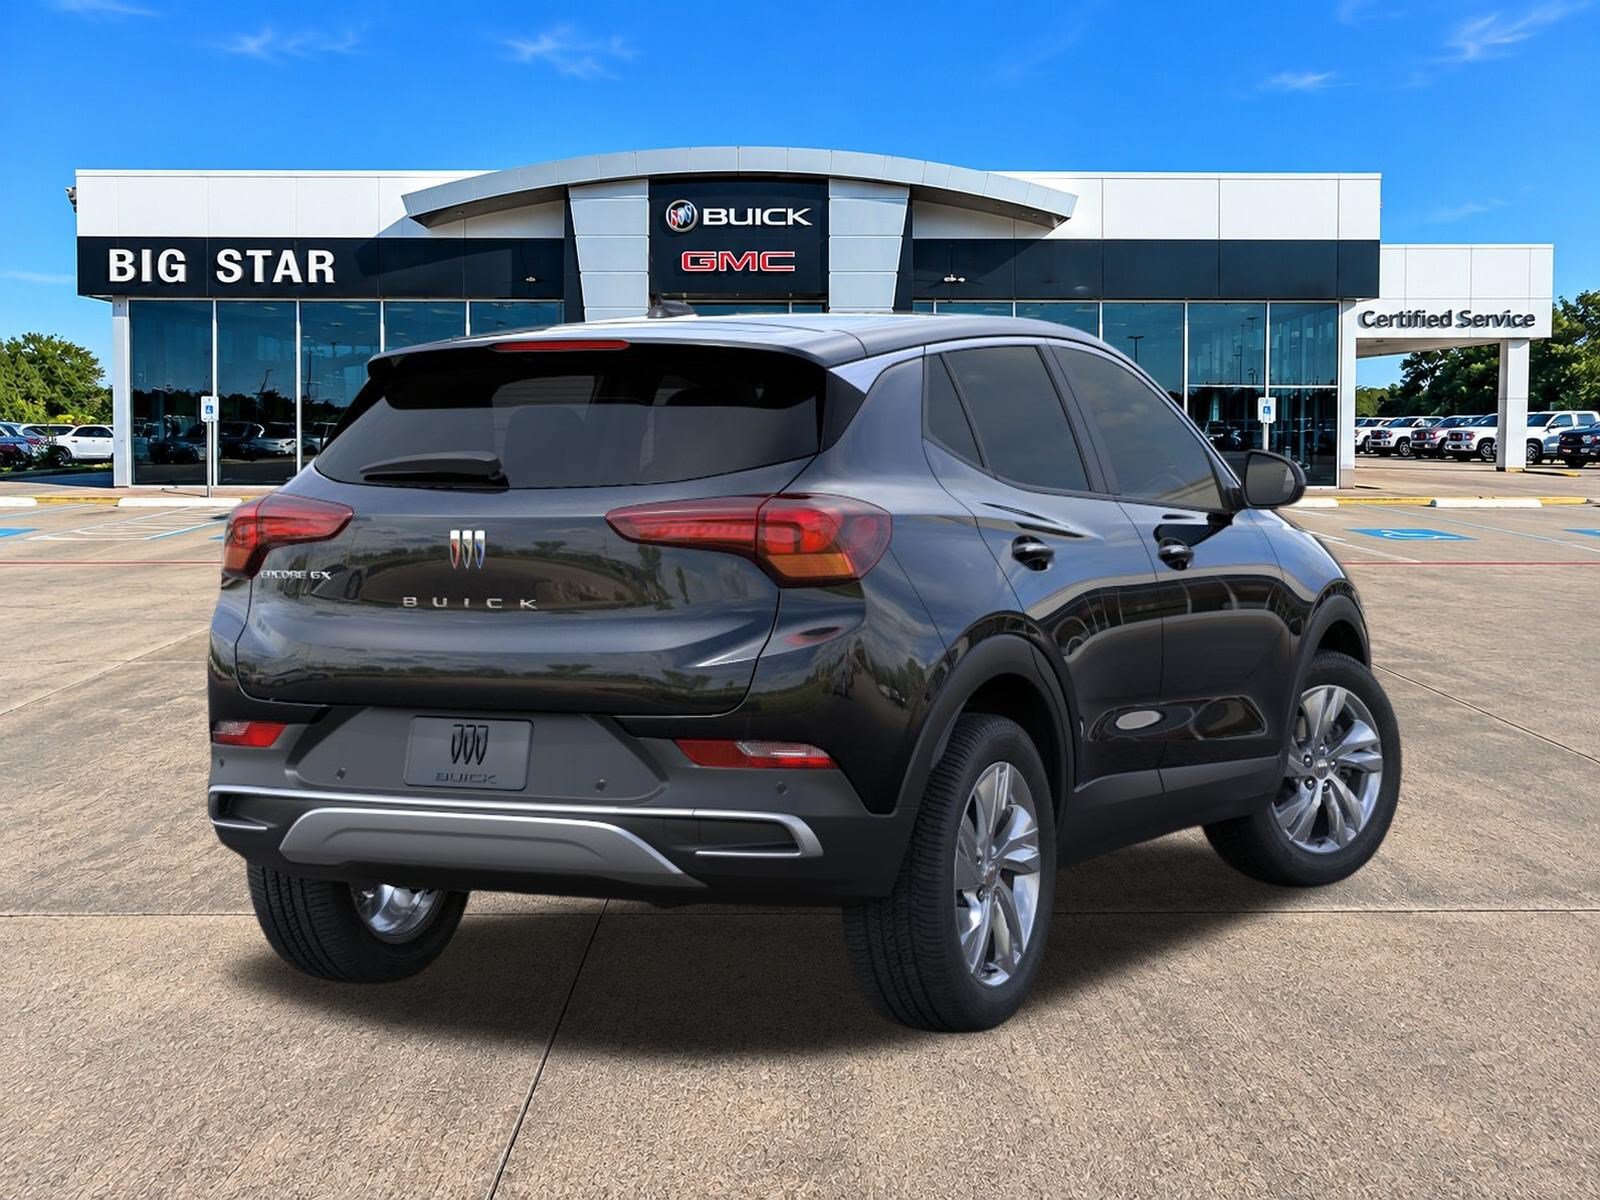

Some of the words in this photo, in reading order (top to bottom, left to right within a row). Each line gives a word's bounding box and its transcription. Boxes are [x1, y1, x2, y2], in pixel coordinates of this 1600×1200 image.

[702, 207, 813, 226] BUICK
[108, 248, 187, 284] BIG
[215, 248, 335, 285] STAR
[681, 251, 796, 272] GMC
[1359, 310, 1453, 328] Certified
[1455, 310, 1536, 328] Service
[260, 570, 307, 580] ENCORE
[310, 570, 332, 581] GX
[402, 596, 538, 610] BUICK
[435, 772, 497, 785] BUICK
